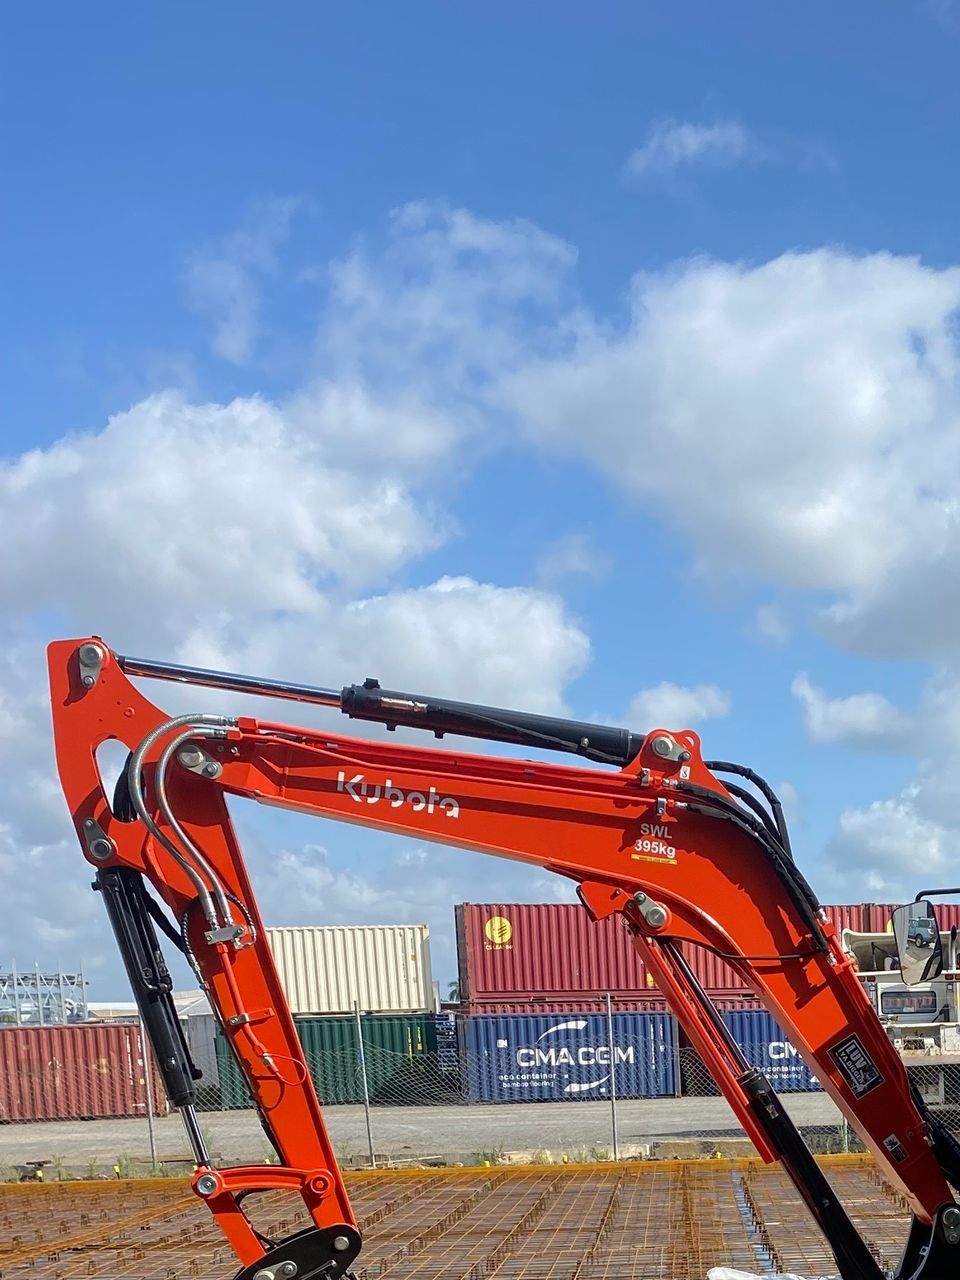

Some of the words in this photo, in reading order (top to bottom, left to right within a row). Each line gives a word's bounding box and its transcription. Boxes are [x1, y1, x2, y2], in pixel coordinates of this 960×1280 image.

[337, 771, 460, 818] Kubota
[640, 823, 673, 839] SWL
[634, 840, 676, 858] 395kg
[516, 1048, 575, 1067] CMA
[578, 1046, 635, 1065] CGM
[768, 1041, 802, 1060] CM
[840, 1052, 848, 1063] YA
[845, 1043, 868, 1069] LUV
[516, 1072, 557, 1080] container
